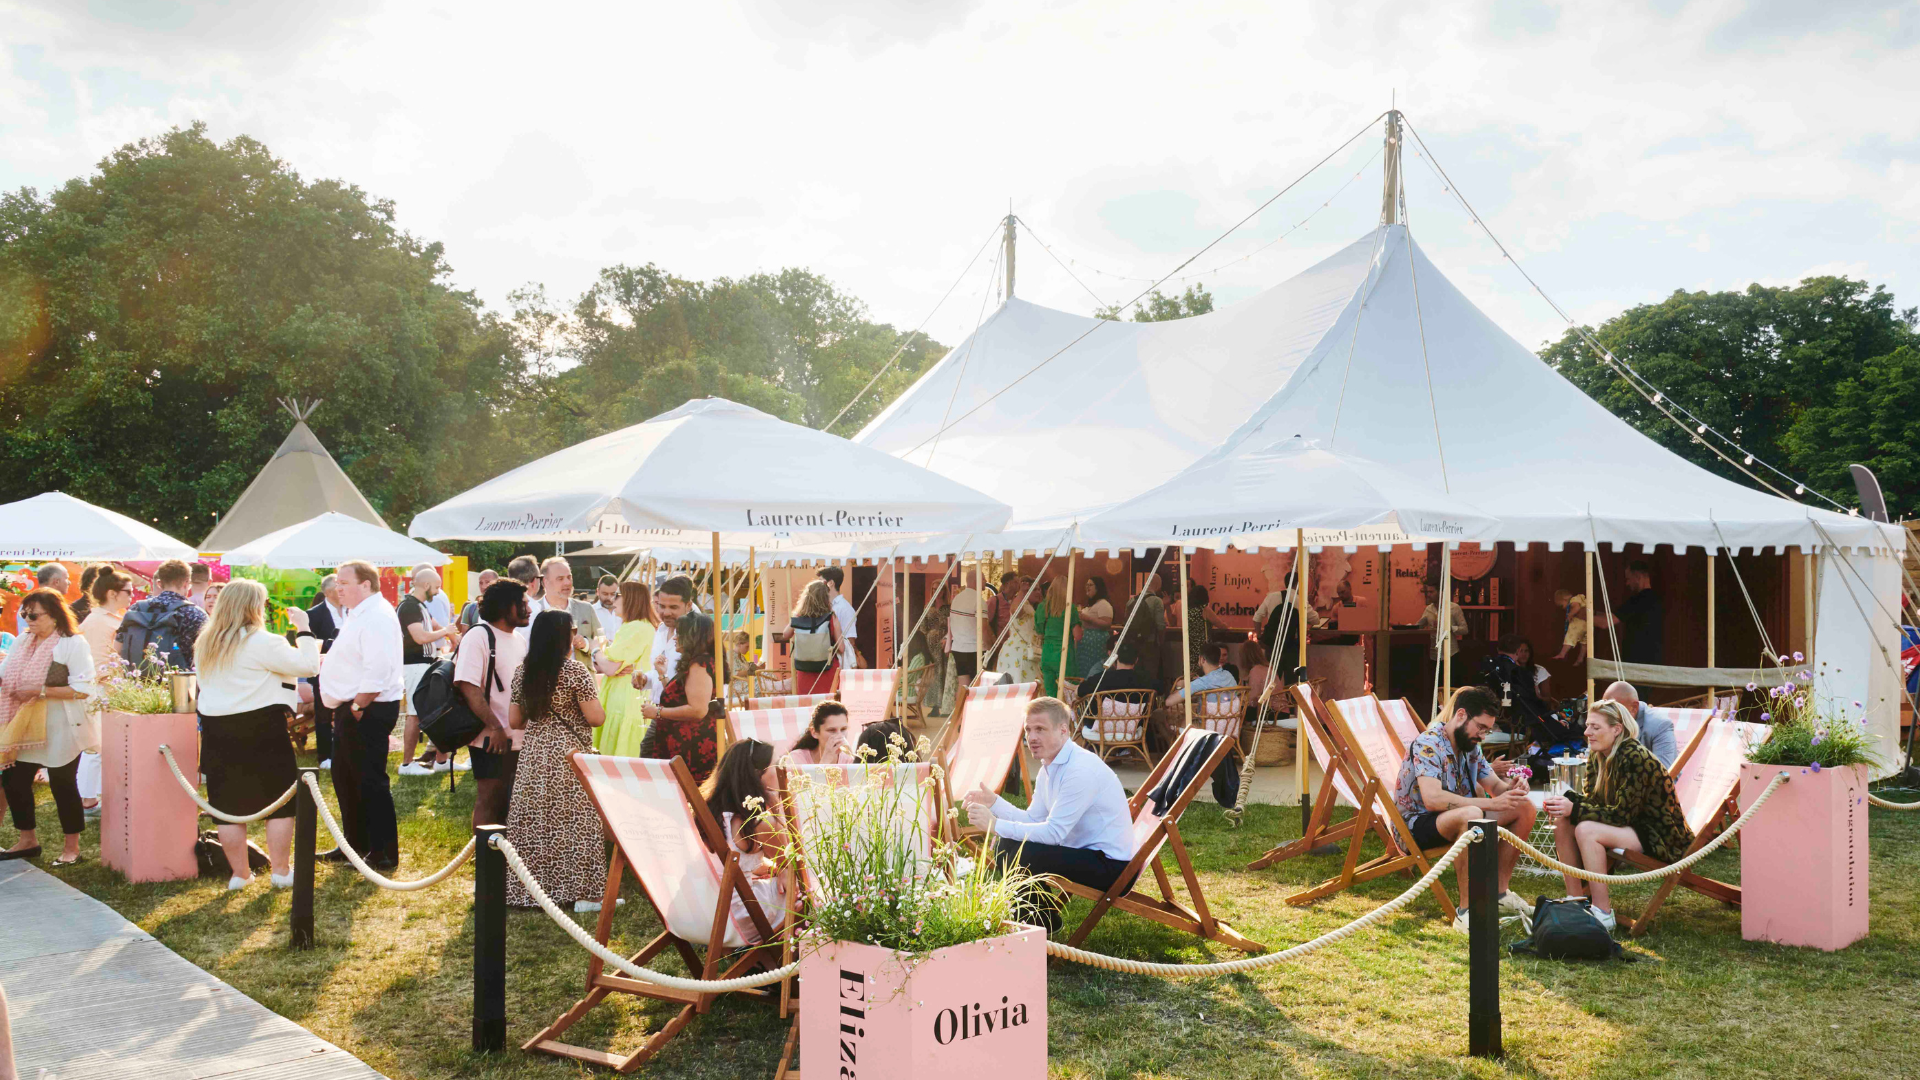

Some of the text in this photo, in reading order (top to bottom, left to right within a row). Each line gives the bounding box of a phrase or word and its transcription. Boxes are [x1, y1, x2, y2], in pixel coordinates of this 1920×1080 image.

[475, 512, 564, 531] Laurent-Perrier
[746, 508, 903, 528] Laurent-Perrier
[1420, 517, 1463, 535] Laurent-Perrier
[1172, 519, 1290, 537] Laurent-Perri
[0, 547, 76, 556] rent-Perrier
[1209, 565, 1219, 592] Mary
[1224, 573, 1252, 590] Enjoy
[1362, 560, 1372, 585] Fun
[770, 579, 776, 588] Me
[1211, 602, 1260, 616] Celebrat
[933, 995, 1030, 1046] Olivia
